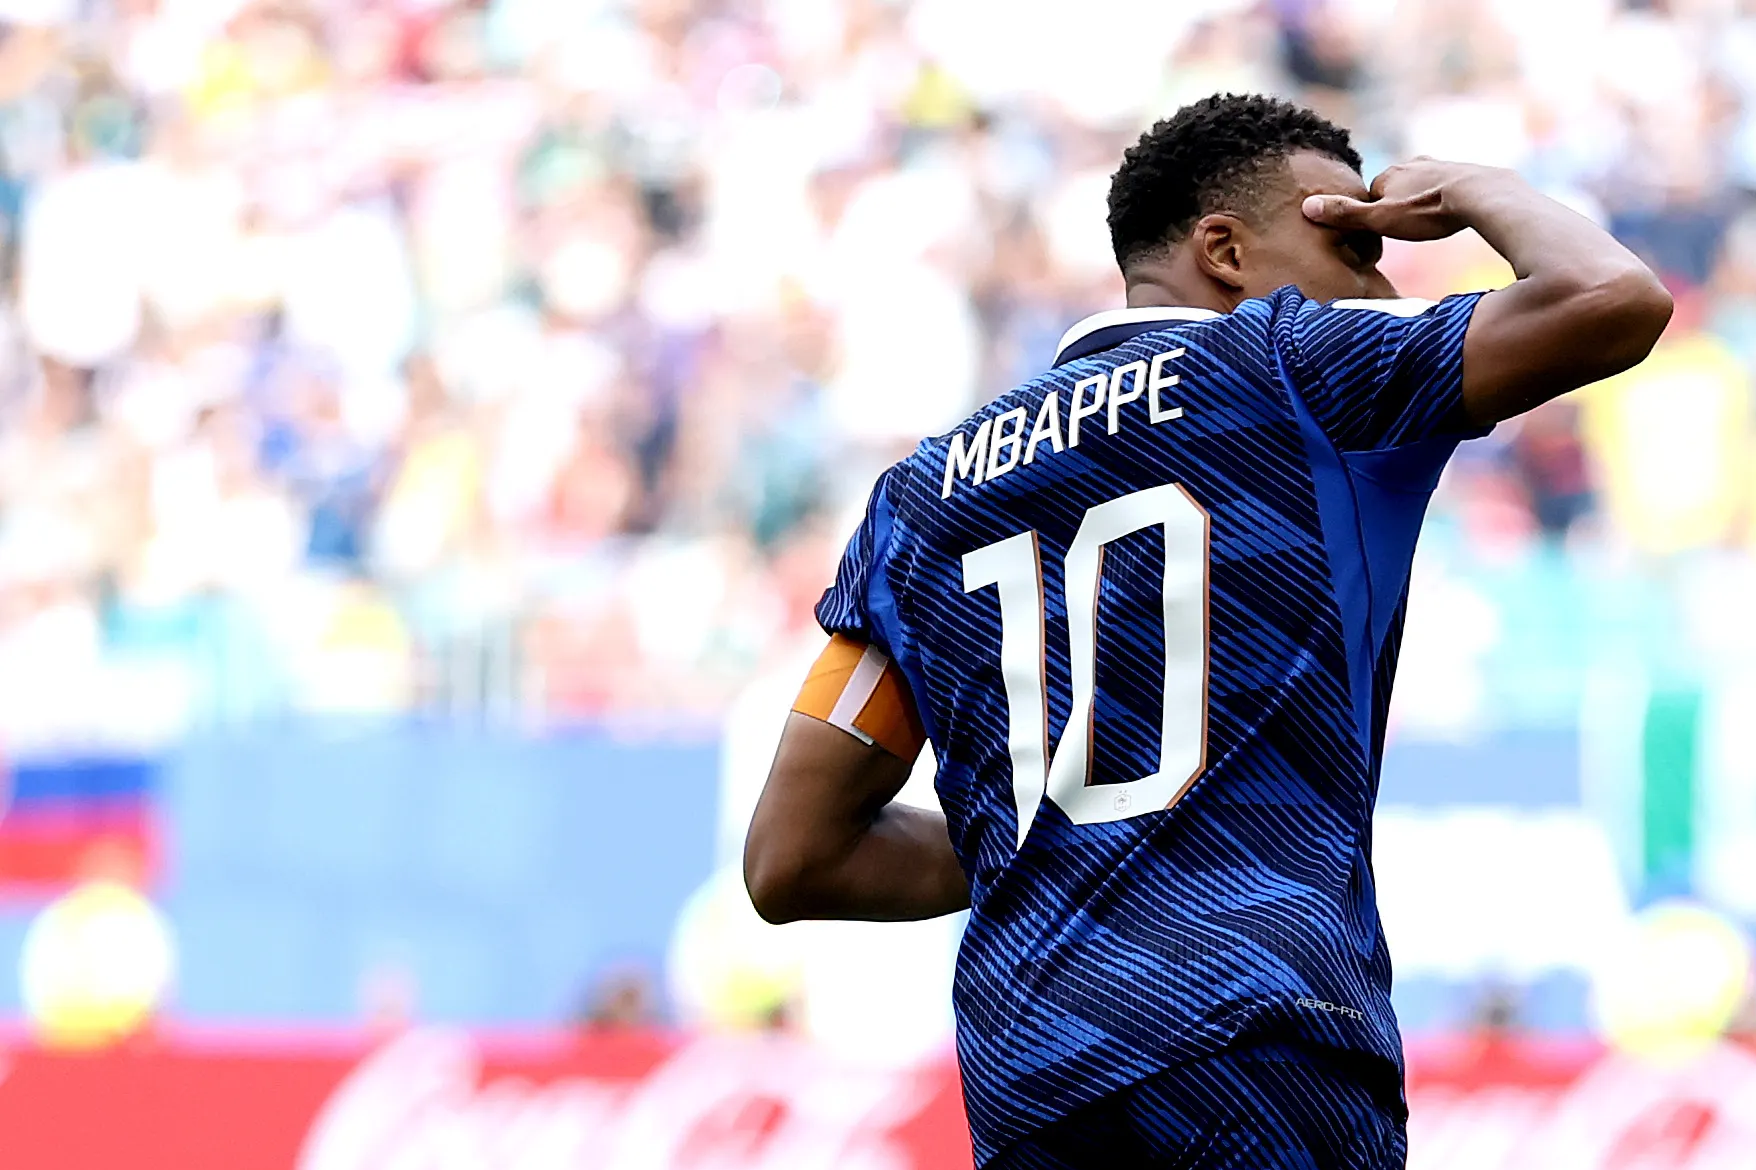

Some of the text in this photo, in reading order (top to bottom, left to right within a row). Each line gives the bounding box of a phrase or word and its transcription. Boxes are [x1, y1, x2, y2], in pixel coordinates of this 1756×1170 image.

[940, 347, 1187, 499] MBAPPE
[962, 482, 1210, 851] 10
[1295, 997, 1364, 1021] AERO-FIT
